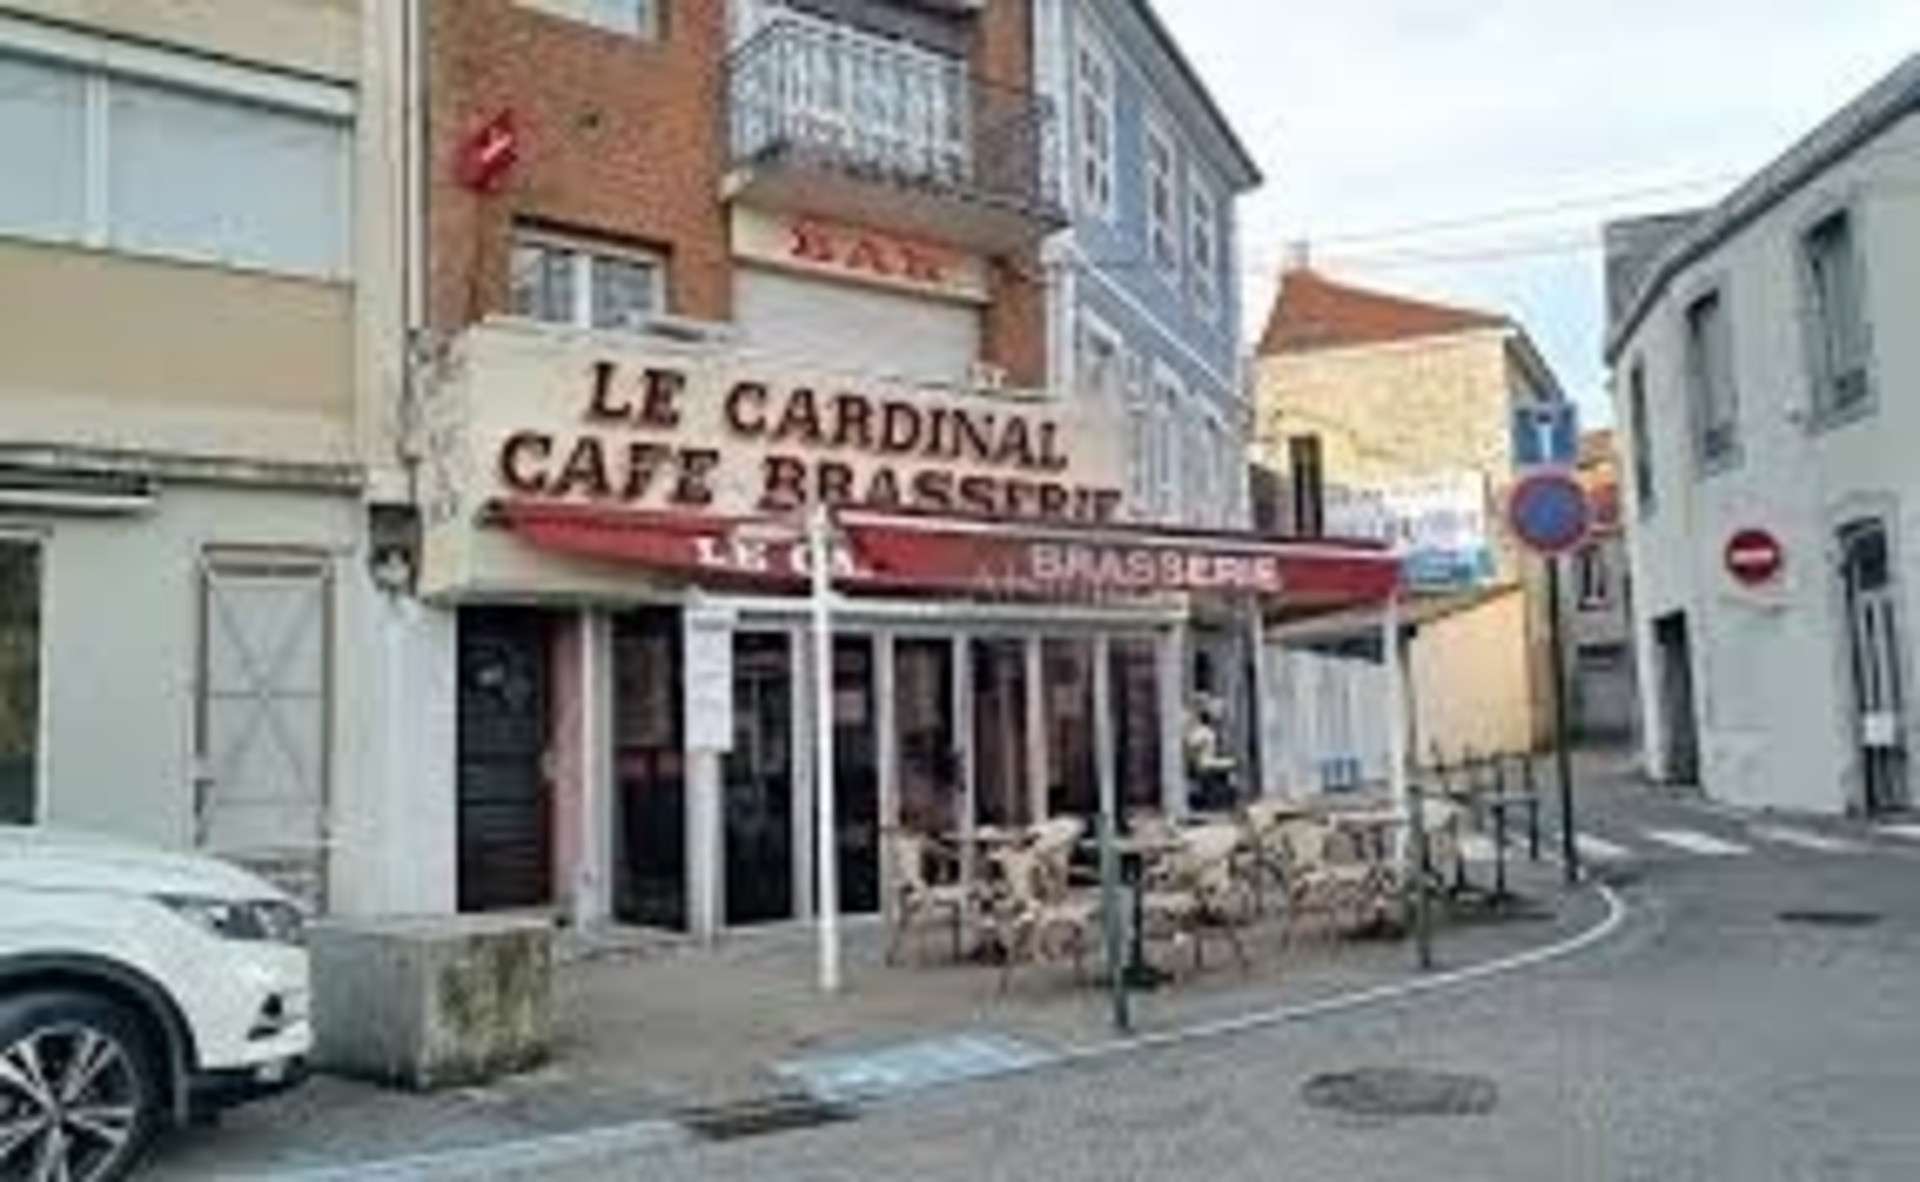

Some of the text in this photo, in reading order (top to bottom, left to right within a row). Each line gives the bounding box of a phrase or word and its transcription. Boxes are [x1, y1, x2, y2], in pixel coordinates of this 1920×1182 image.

[788, 217, 946, 282] BAR
[583, 361, 1070, 471] LE CARDINAL
[499, 429, 1123, 526] CAFE BRASSERIE
[696, 536, 768, 572] LE
[1031, 544, 1282, 592] BRASSERIE
